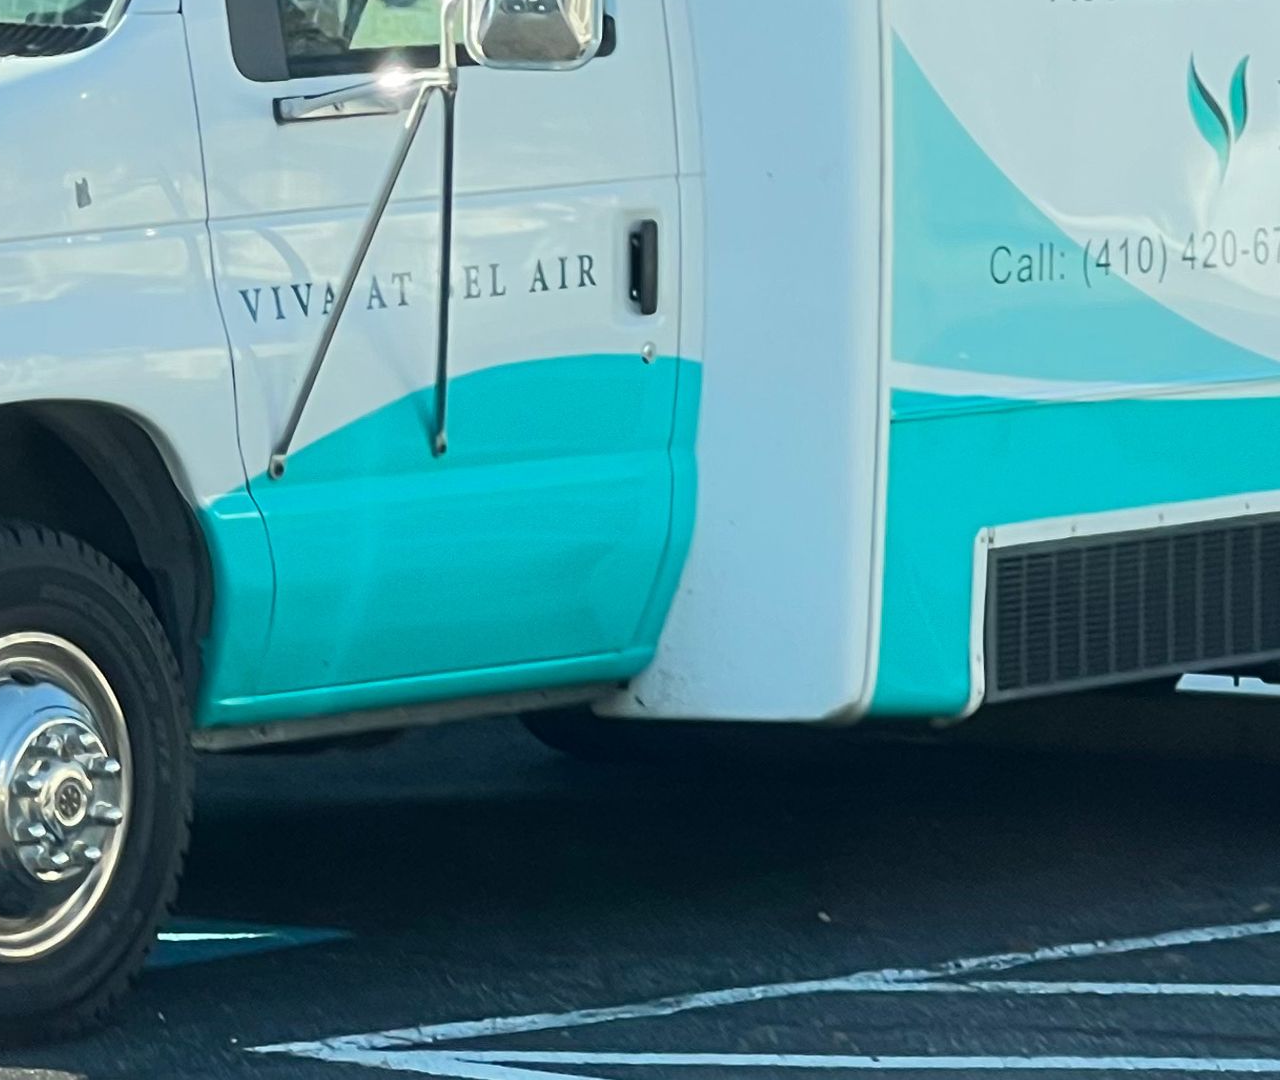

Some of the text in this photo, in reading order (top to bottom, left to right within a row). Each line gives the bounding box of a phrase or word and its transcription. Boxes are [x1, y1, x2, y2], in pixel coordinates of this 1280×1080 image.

[365, 271, 413, 311] AT
[438, 263, 508, 300] EL
[528, 253, 599, 294] AIR
[989, 241, 1066, 285] Call:
[1082, 234, 1169, 289] (410)
